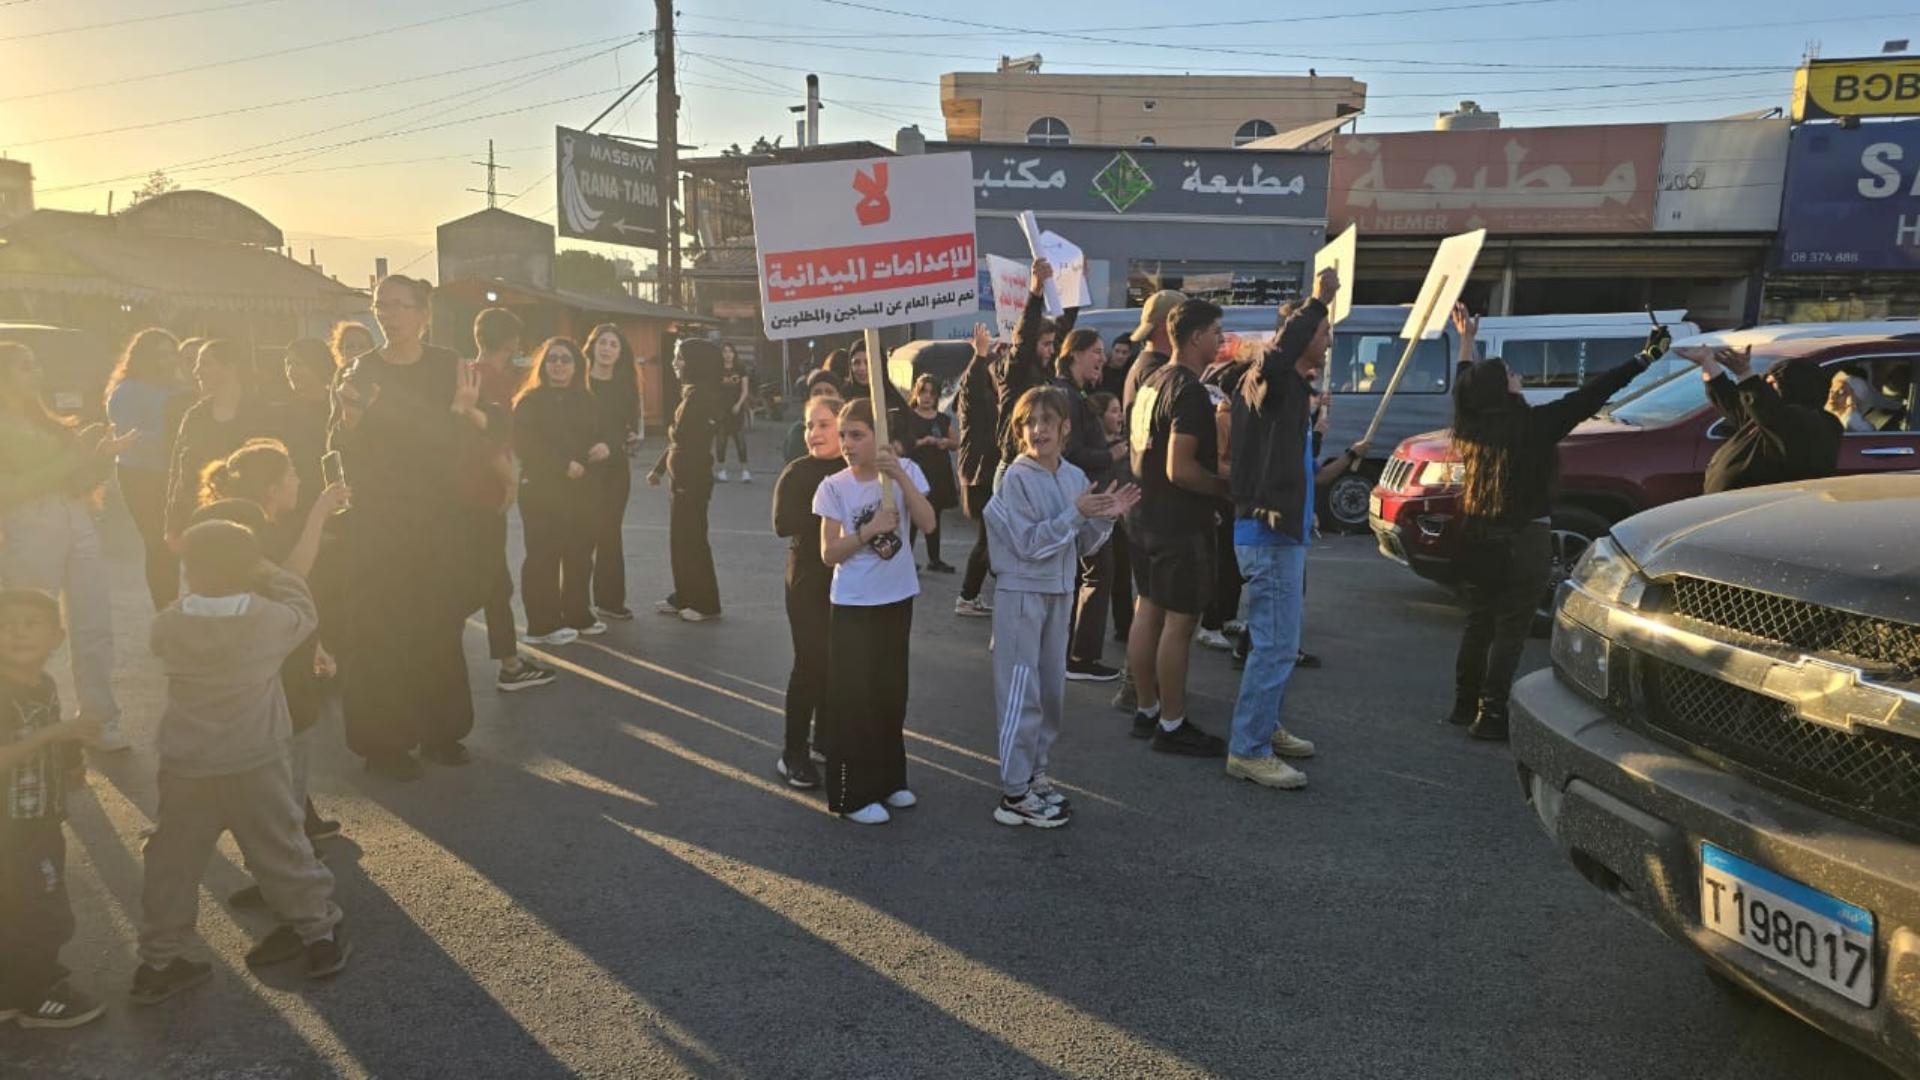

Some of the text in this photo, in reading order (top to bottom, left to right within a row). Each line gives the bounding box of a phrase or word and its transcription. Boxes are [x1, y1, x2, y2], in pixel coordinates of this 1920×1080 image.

[590, 143, 655, 173] MASSAYA
[974, 157, 1305, 205] مطبعة مكتب
[1344, 136, 1638, 211] مطبعة
[852, 162, 891, 226] لا
[1374, 213, 1449, 231] NEMER
[768, 244, 972, 297] للإعدامات الميدانية
[770, 289, 975, 329] نعم للعفو العام عن المساجين والمطلوبين
[1705, 877, 1867, 989] T198017
